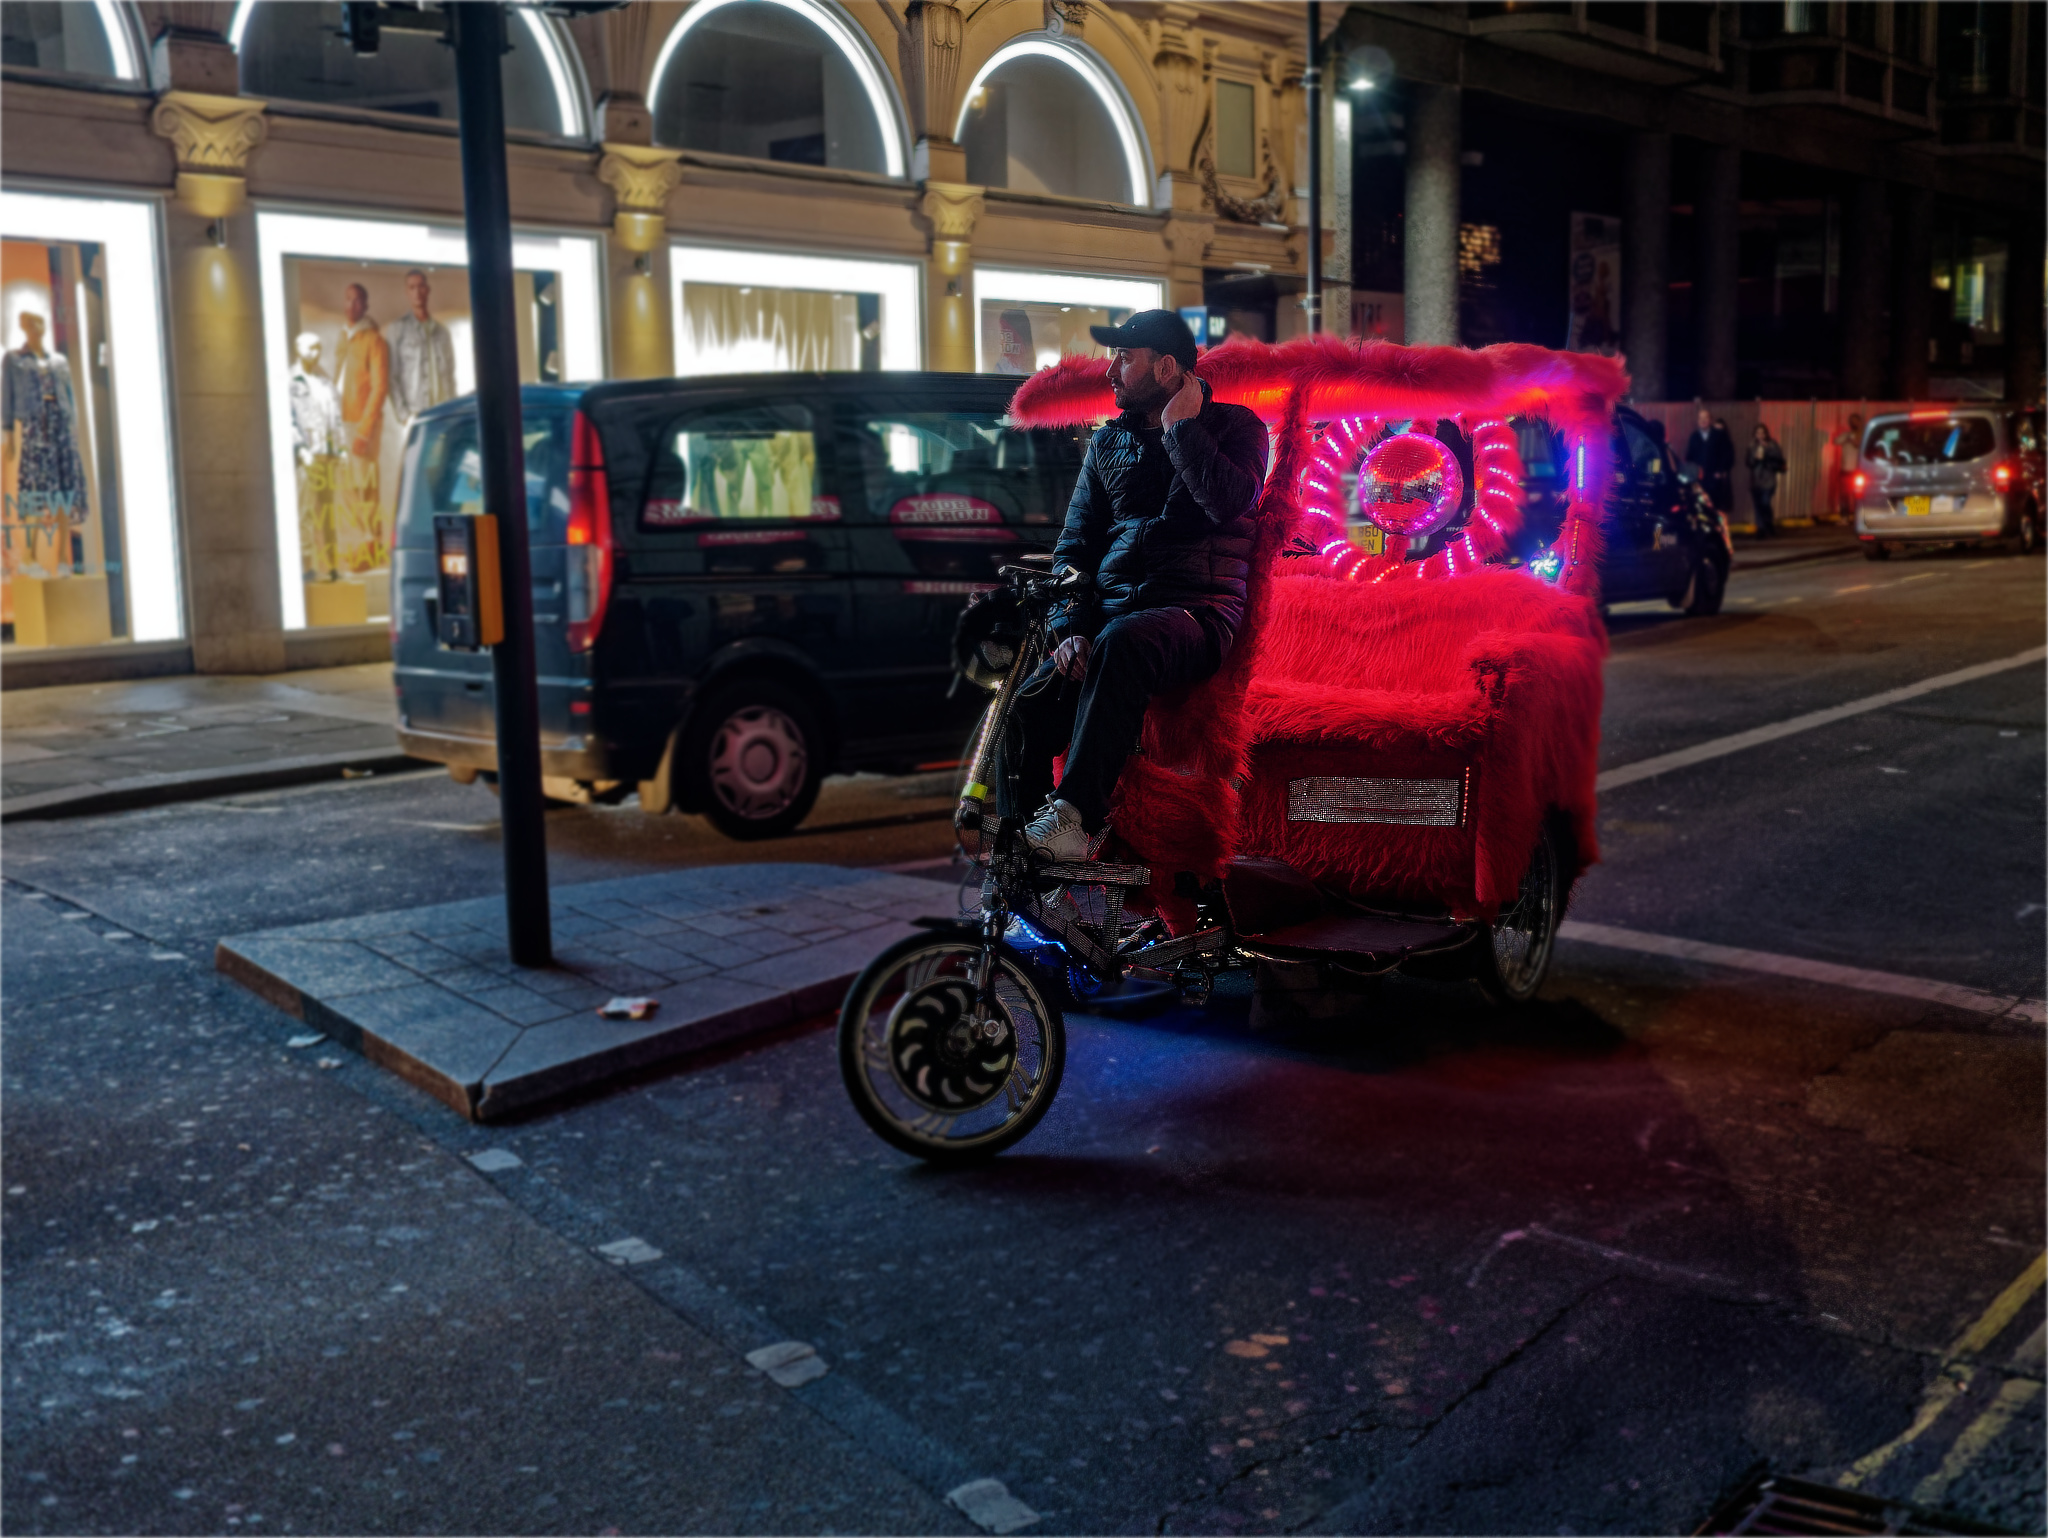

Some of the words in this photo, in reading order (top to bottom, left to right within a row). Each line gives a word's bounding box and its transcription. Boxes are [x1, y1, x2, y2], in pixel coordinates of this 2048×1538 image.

[1208, 316, 1226, 336] GAP
[5, 490, 76, 519] NEW
[1, 522, 59, 549] TTY
